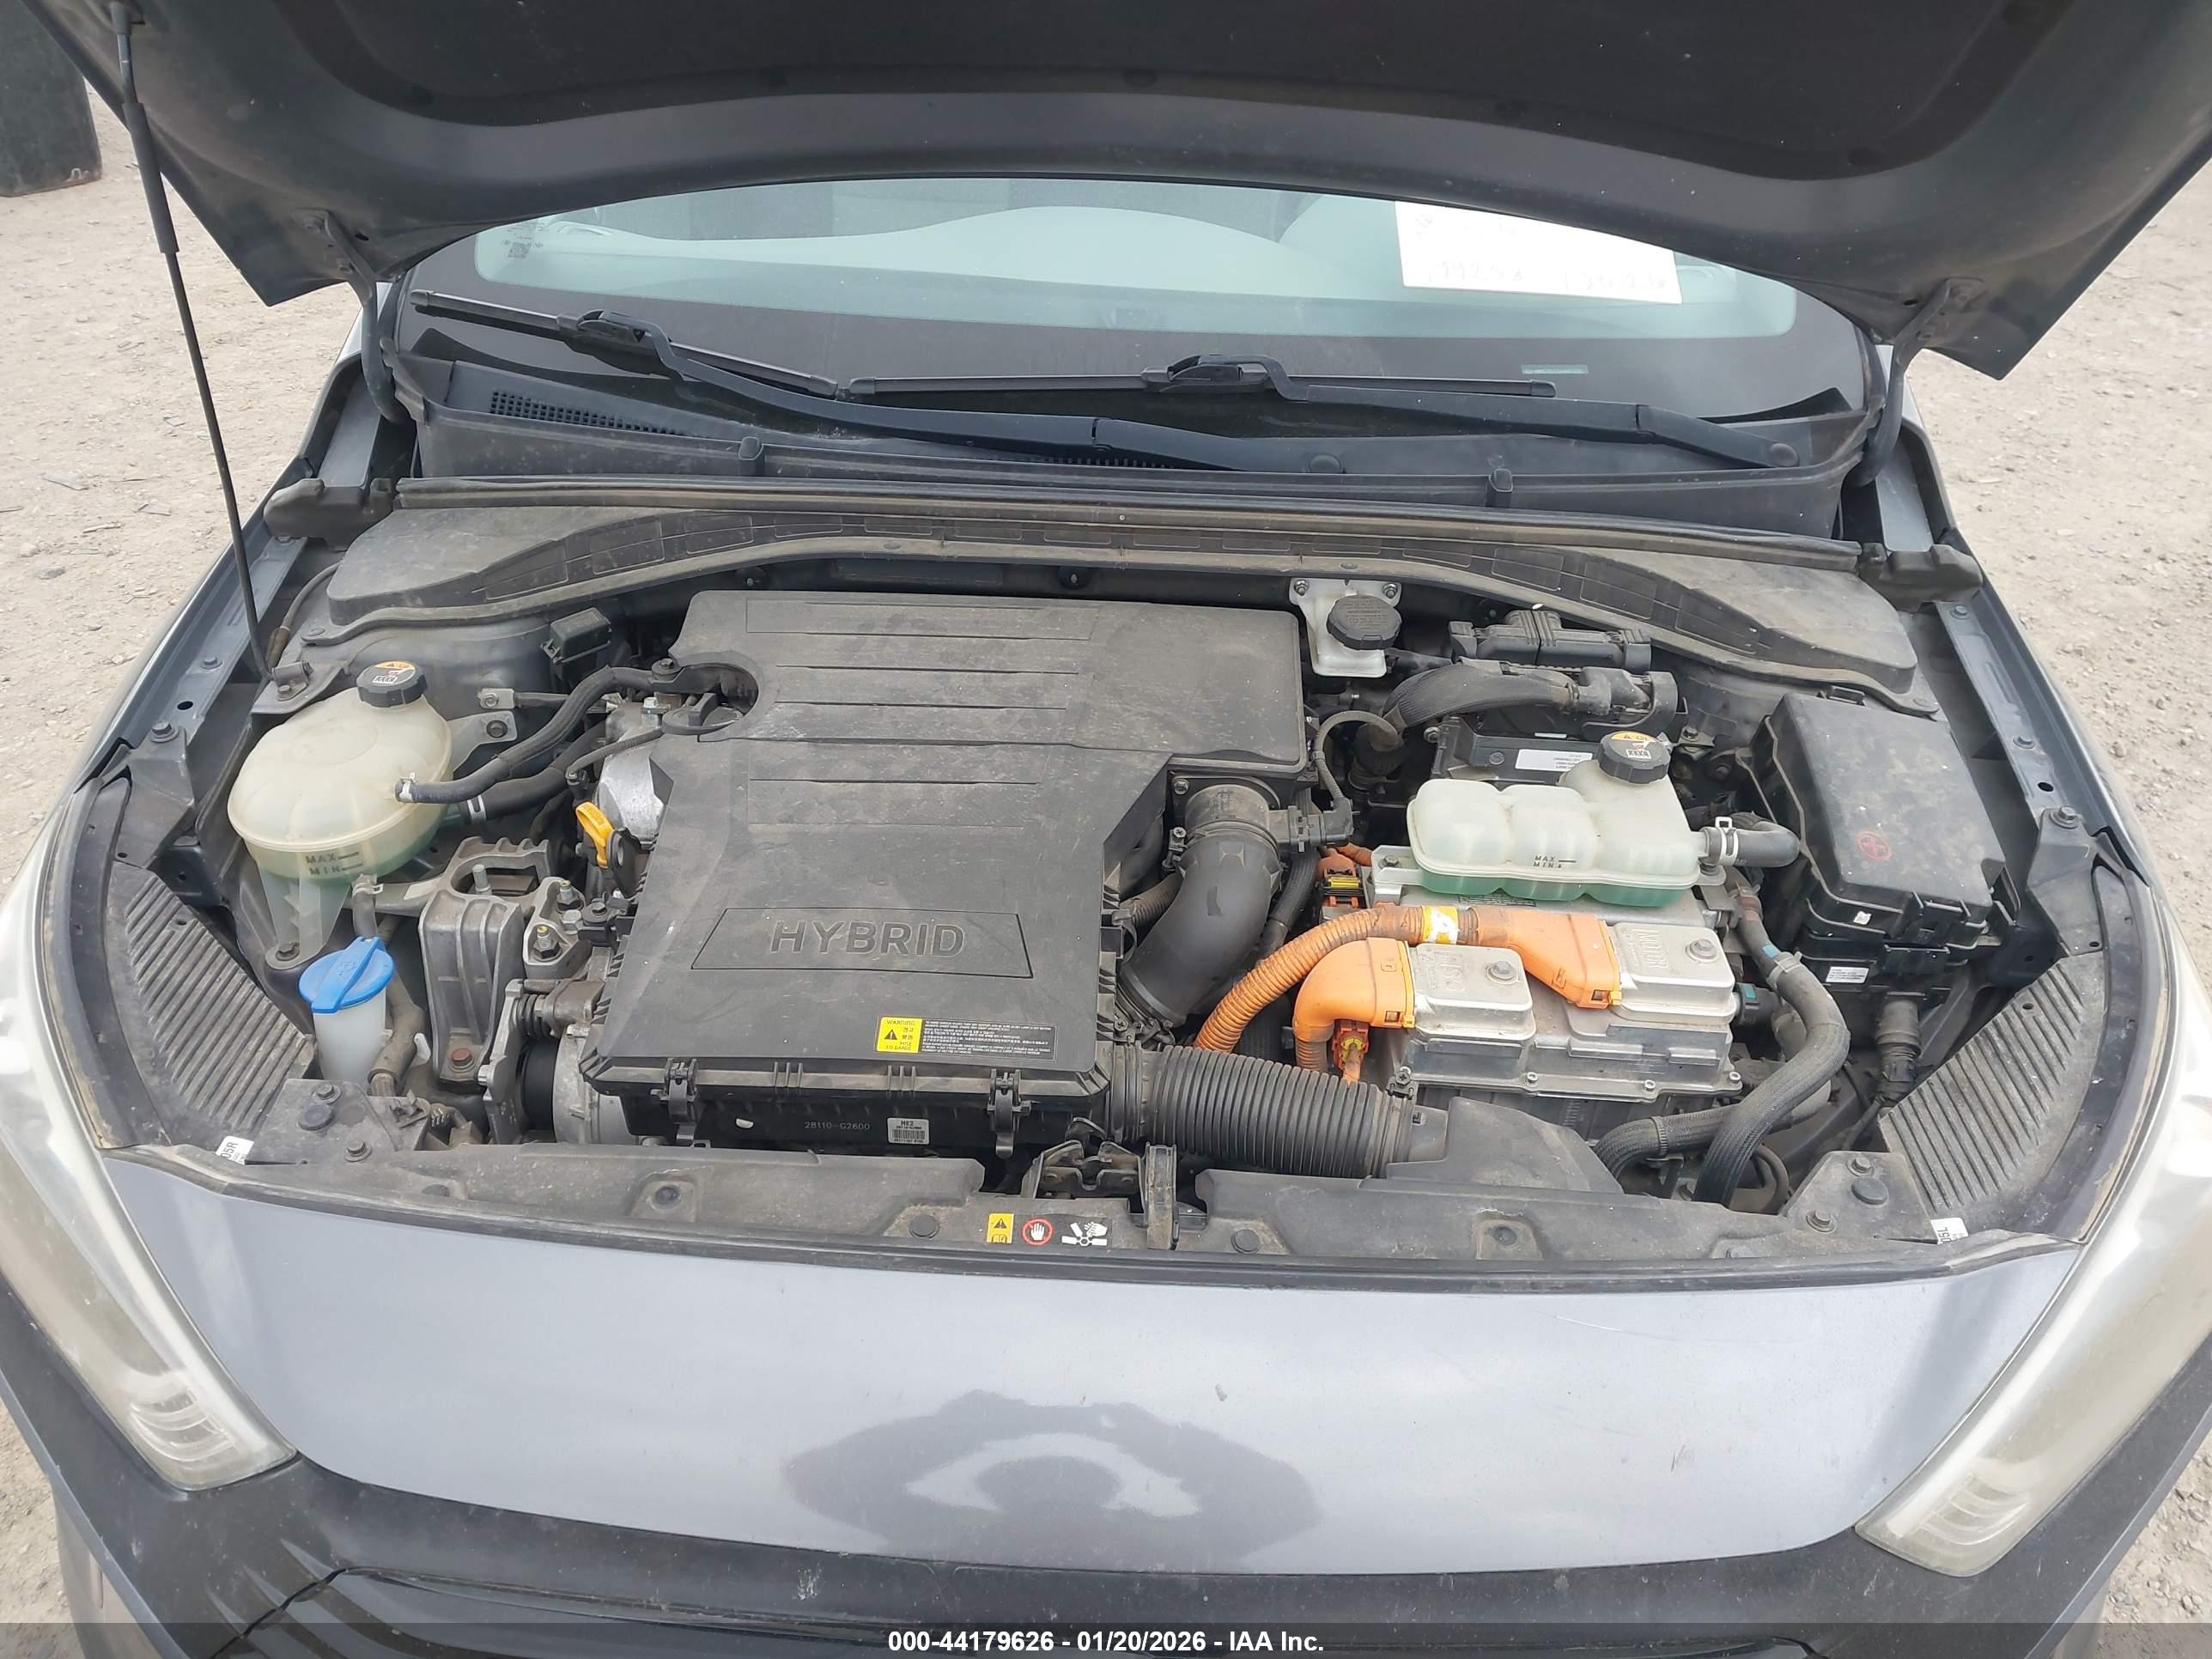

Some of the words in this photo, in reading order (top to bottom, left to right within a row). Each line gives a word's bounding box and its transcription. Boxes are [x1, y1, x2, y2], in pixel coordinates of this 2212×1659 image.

[305, 853, 337, 864] MAX
[309, 865, 341, 875] MIN
[769, 919, 966, 957] HYBRID
[220, 1141, 240, 1159] 05R
